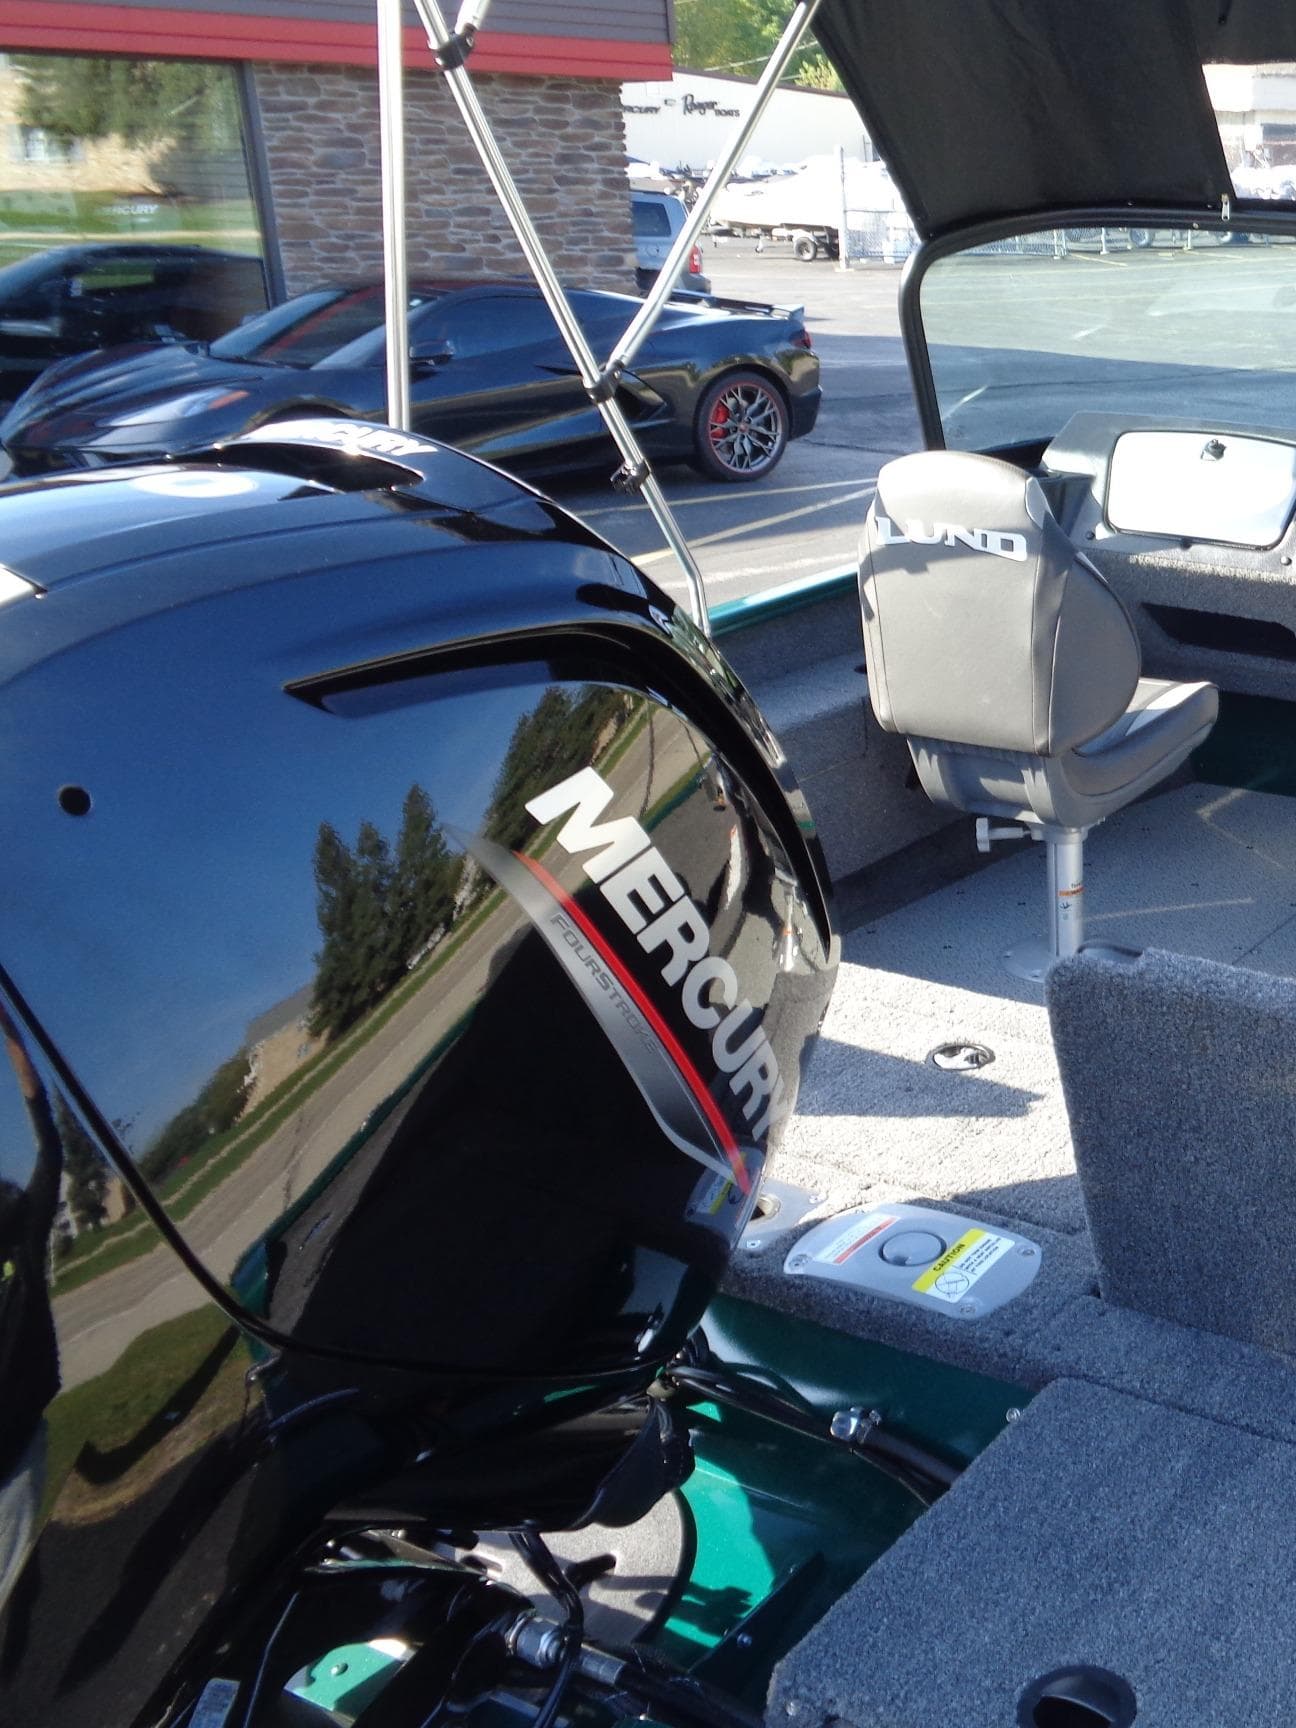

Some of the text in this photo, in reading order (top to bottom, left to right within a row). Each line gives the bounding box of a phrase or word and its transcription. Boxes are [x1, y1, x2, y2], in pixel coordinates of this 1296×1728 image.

[682, 94, 718, 115] Ranger
[874, 506, 1028, 562] LUND
[550, 913, 657, 1055] FOURSTROKE
[933, 1243, 966, 1272] CAUTION
